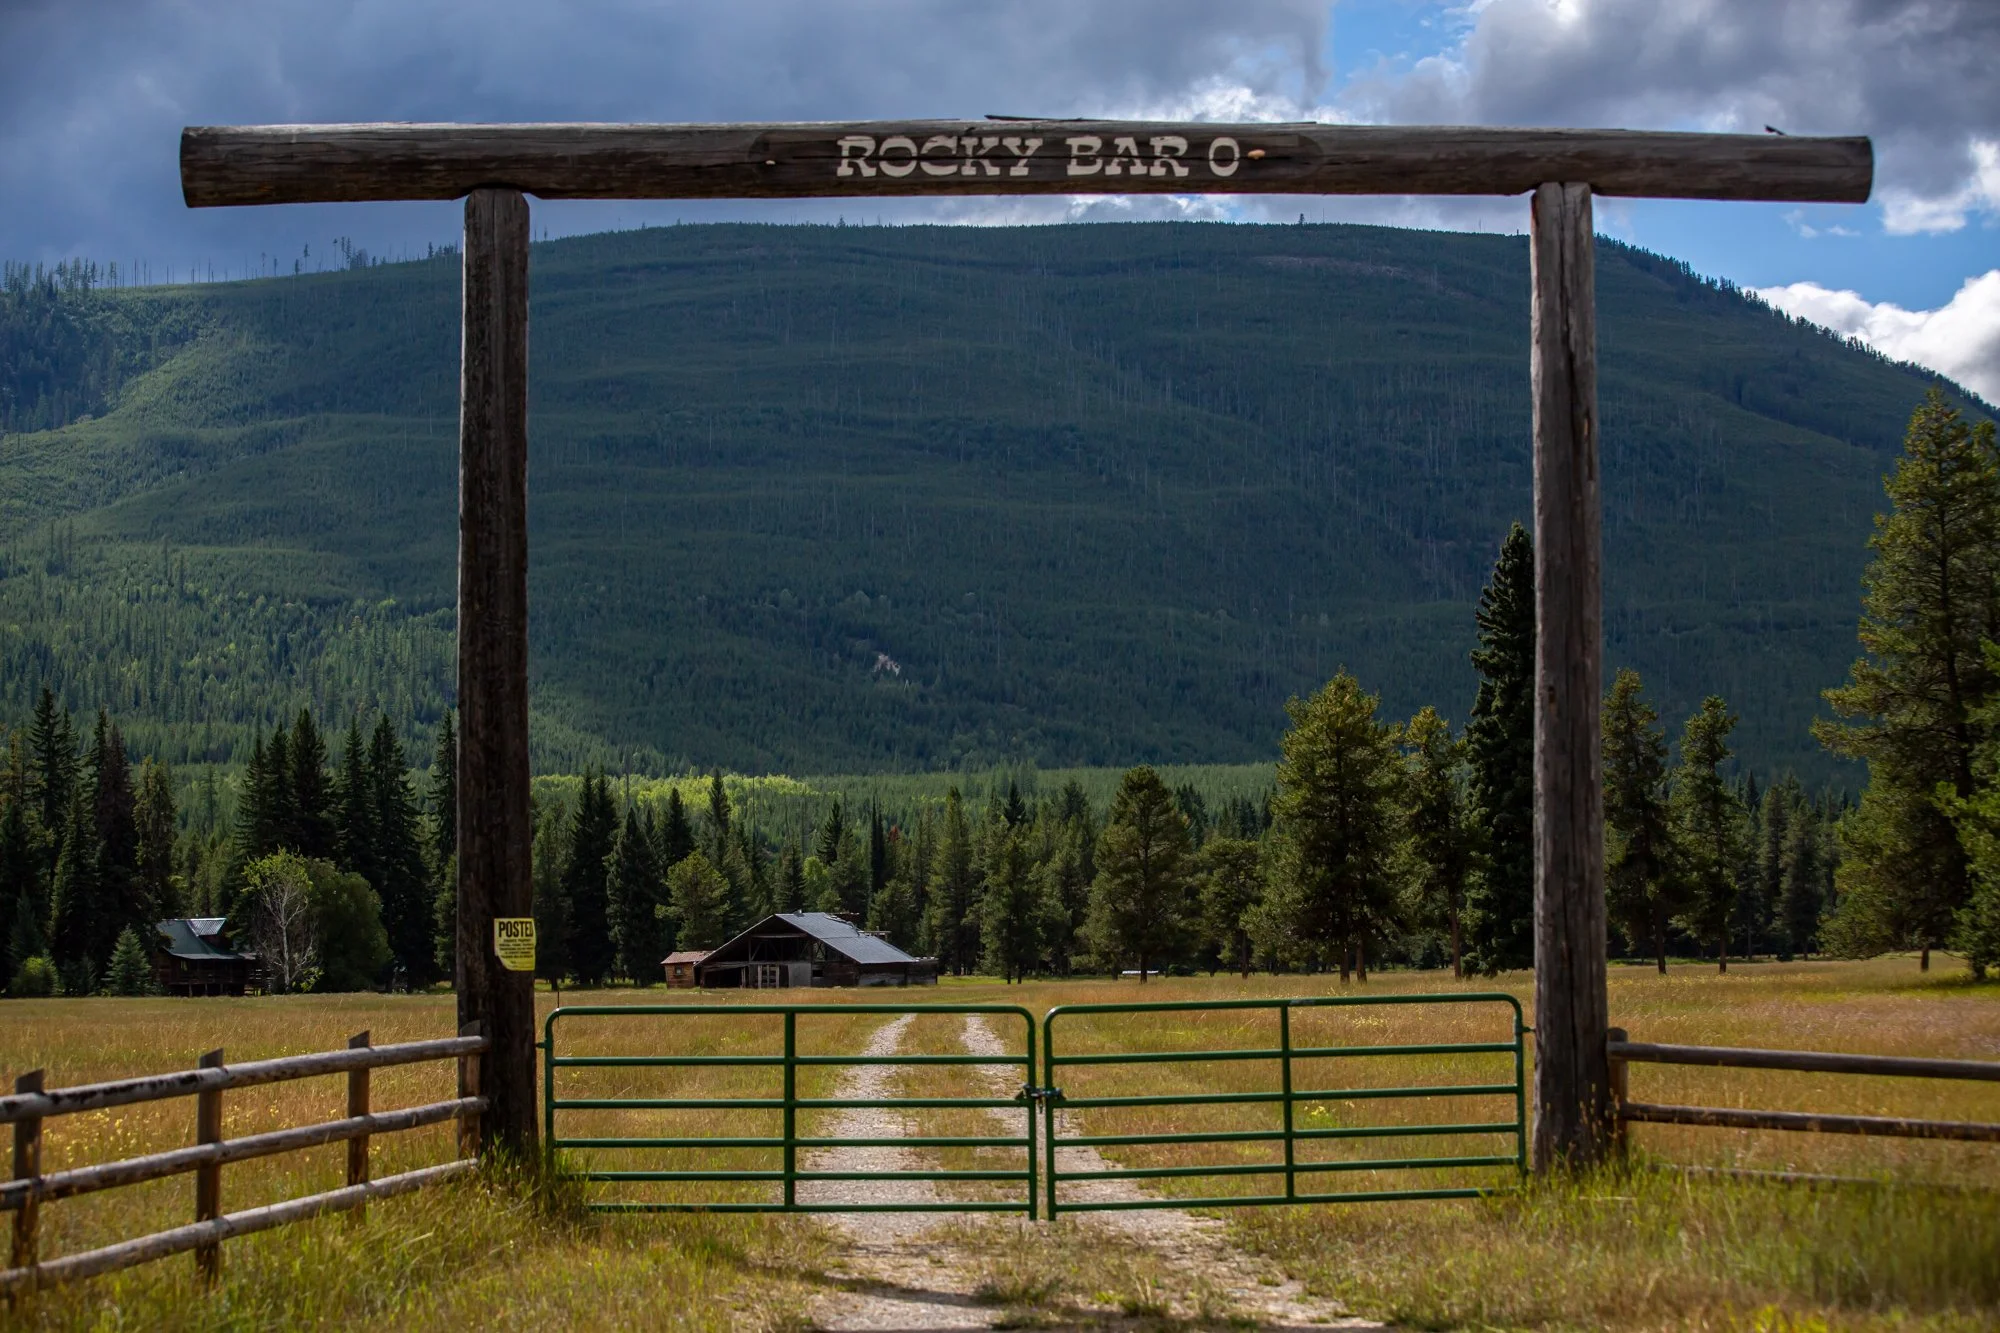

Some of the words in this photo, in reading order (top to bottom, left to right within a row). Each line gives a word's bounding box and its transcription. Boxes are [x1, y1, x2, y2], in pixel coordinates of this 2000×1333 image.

[836, 136, 1044, 178] ROCKY
[1065, 136, 1189, 178] BAR
[1208, 136, 1241, 178] O
